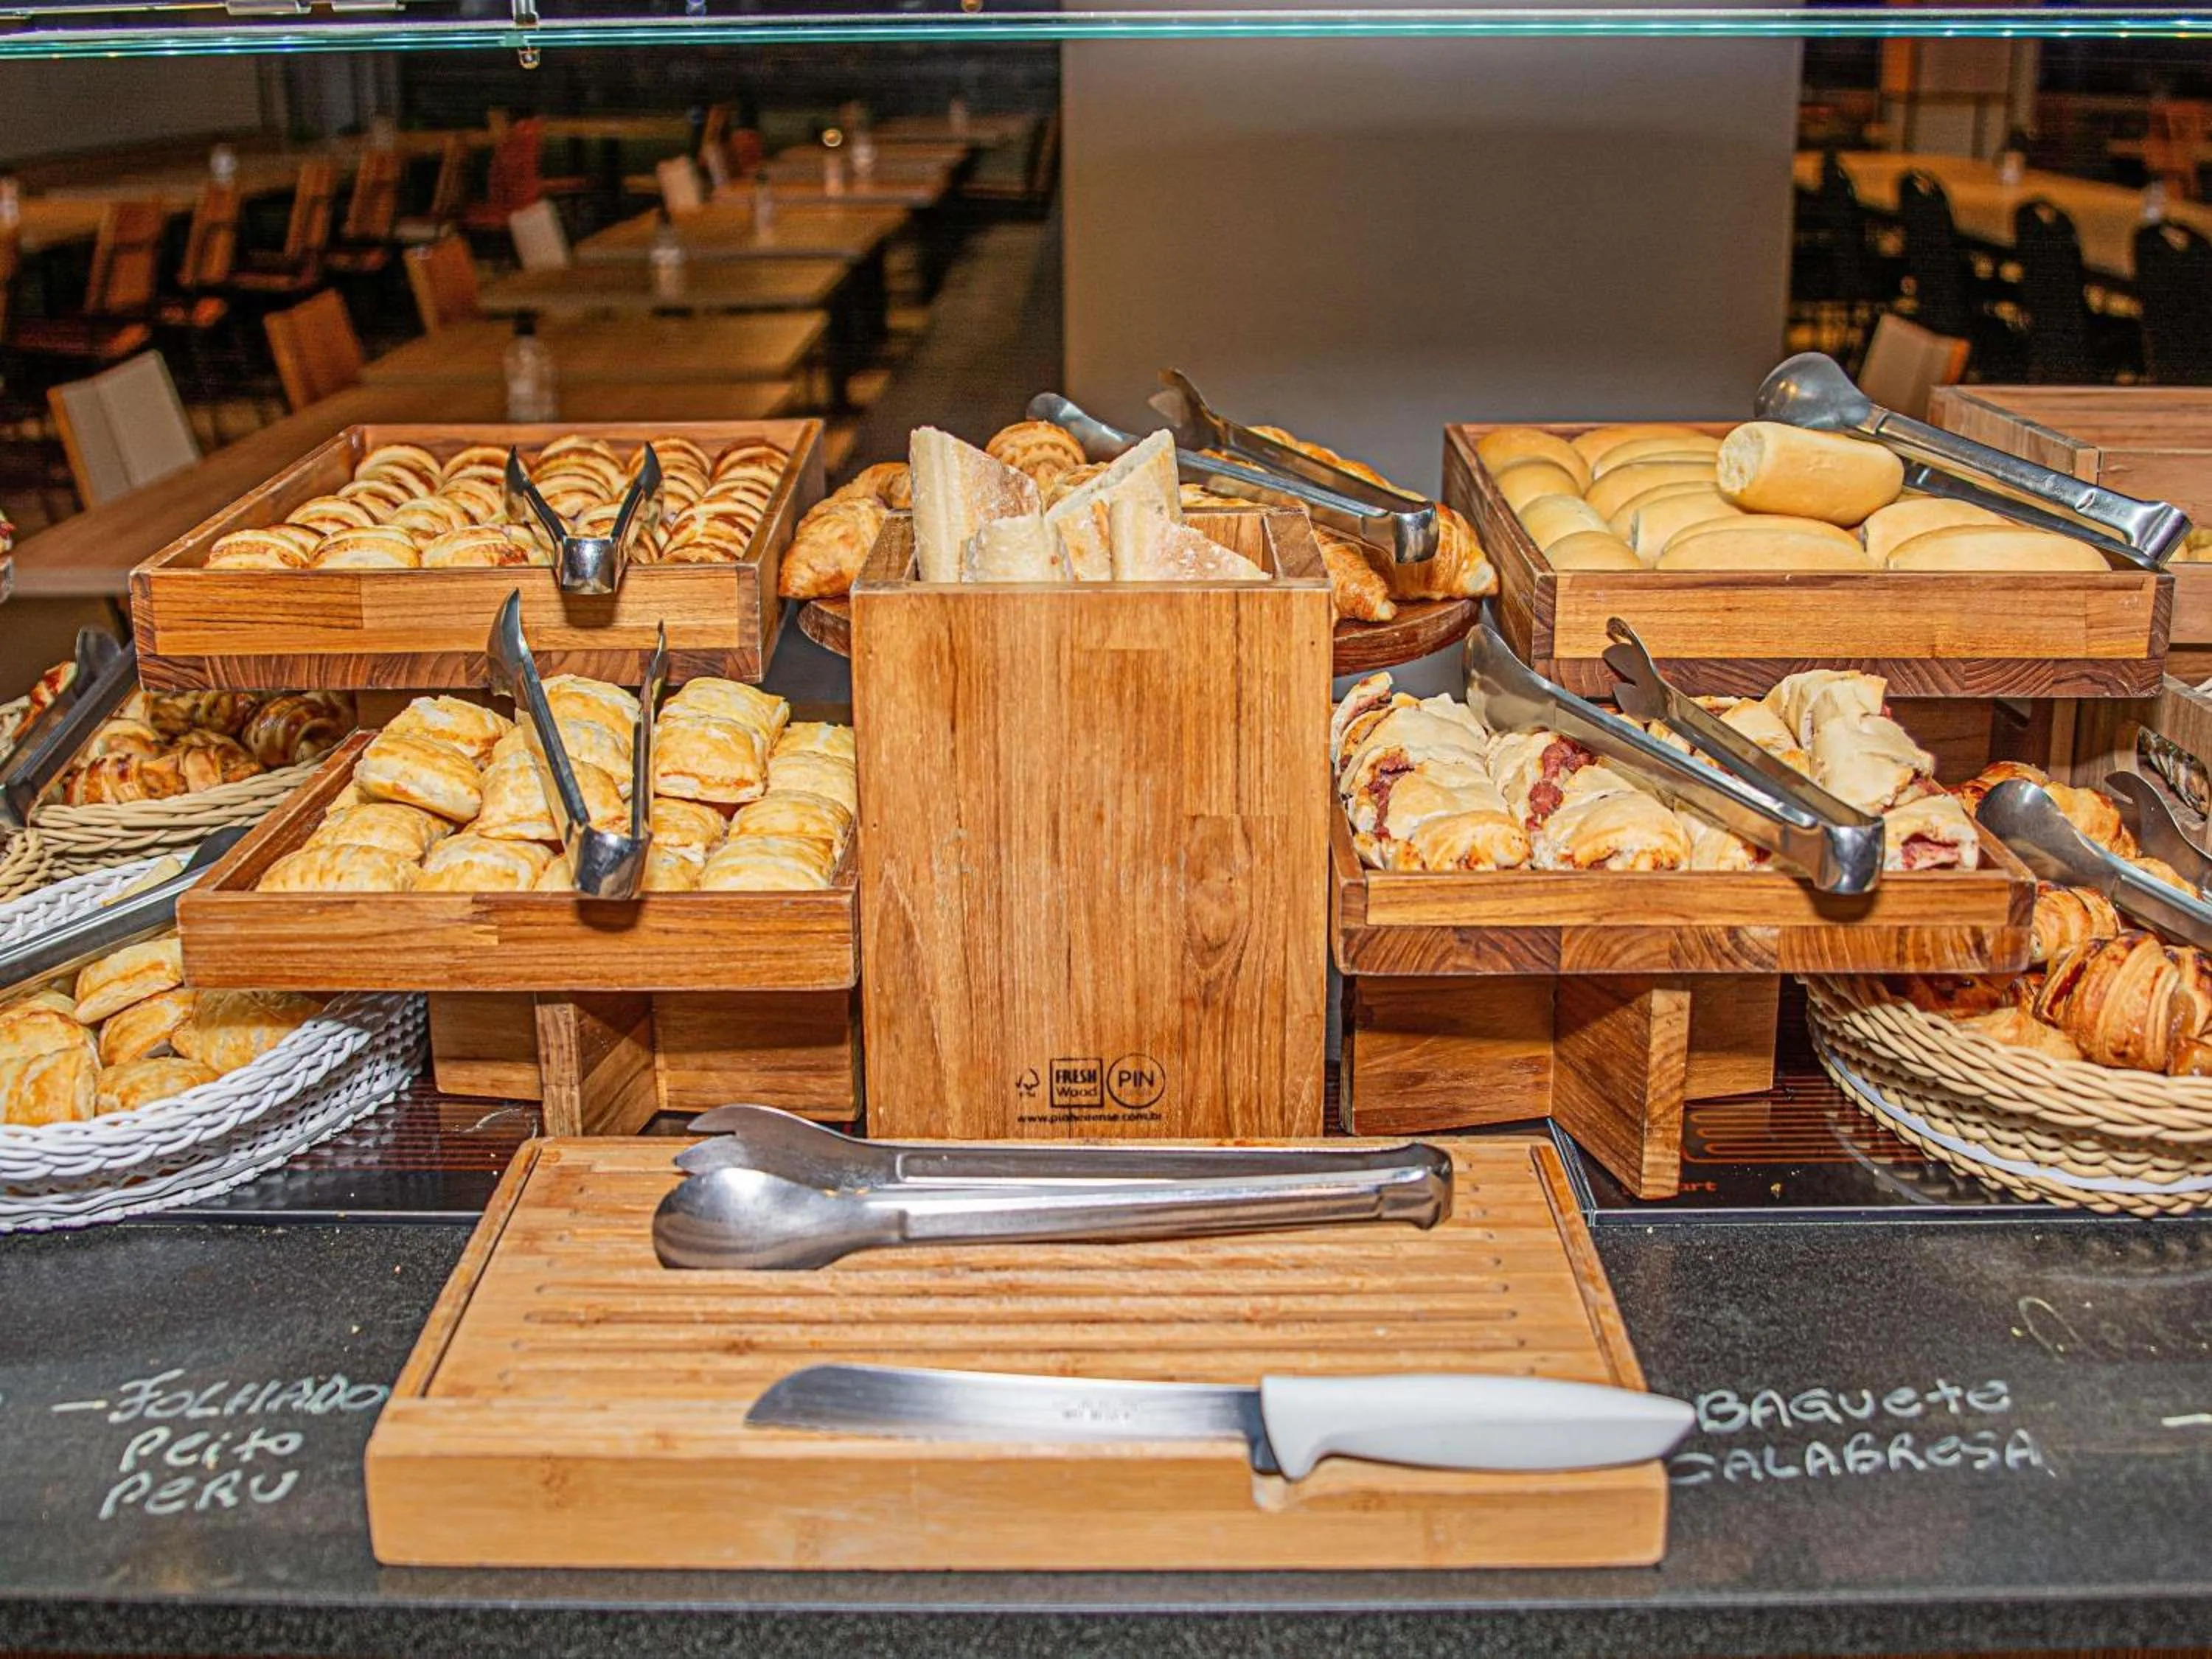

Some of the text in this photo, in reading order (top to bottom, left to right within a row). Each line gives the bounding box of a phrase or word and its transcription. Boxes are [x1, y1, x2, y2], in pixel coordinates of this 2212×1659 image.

[1055, 1070, 1097, 1084] FRESH
[1119, 1070, 1154, 1088] PIN
[1057, 1087, 1097, 1097] Wood
